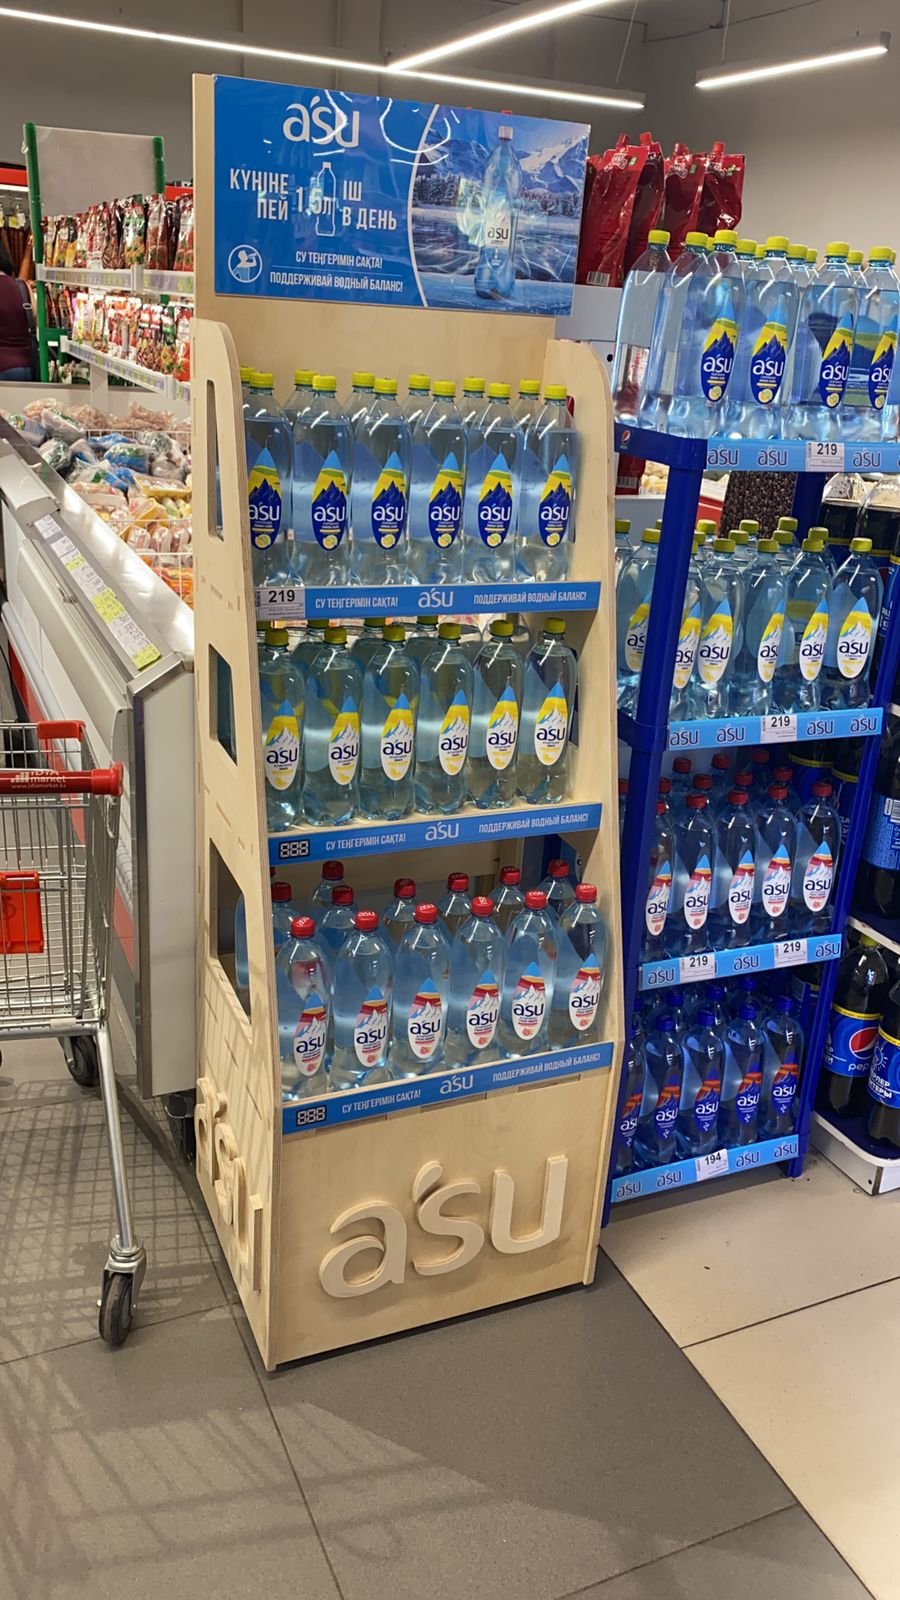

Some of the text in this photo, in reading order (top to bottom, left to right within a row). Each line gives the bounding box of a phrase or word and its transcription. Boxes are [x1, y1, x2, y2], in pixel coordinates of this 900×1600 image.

[257, 196, 288, 220] ПЕЙ
[342, 207, 351, 226] В
[356, 208, 397, 230] ДЕНЬ
[295, 251, 307, 263] СУ
[270, 271, 403, 292] ПОДДЕРЖИВАЙ ВОДНЫЙ БАЛАНС!
[817, 443, 837, 455] 219
[268, 589, 296, 603] 219
[474, 590, 587, 605] ПОДДЕРЖИВАЙ ВОДНЫЙ БАЛАНС!
[315, 598, 326, 609] СУ
[771, 715, 790, 728] 219
[478, 812, 588, 833] ПОДДЕРЖИВАЙ ВОДНЫЙ БАЛАНС!
[325, 839, 336, 851] СУ
[783, 941, 801, 954] 219
[690, 955, 708, 968] 219
[492, 1053, 600, 1082] ПОДДЕРЖИВАЙ ВОДНЫЙ БАЛАНС!
[342, 1103, 352, 1114] СУ
[705, 1153, 722, 1165] 194
